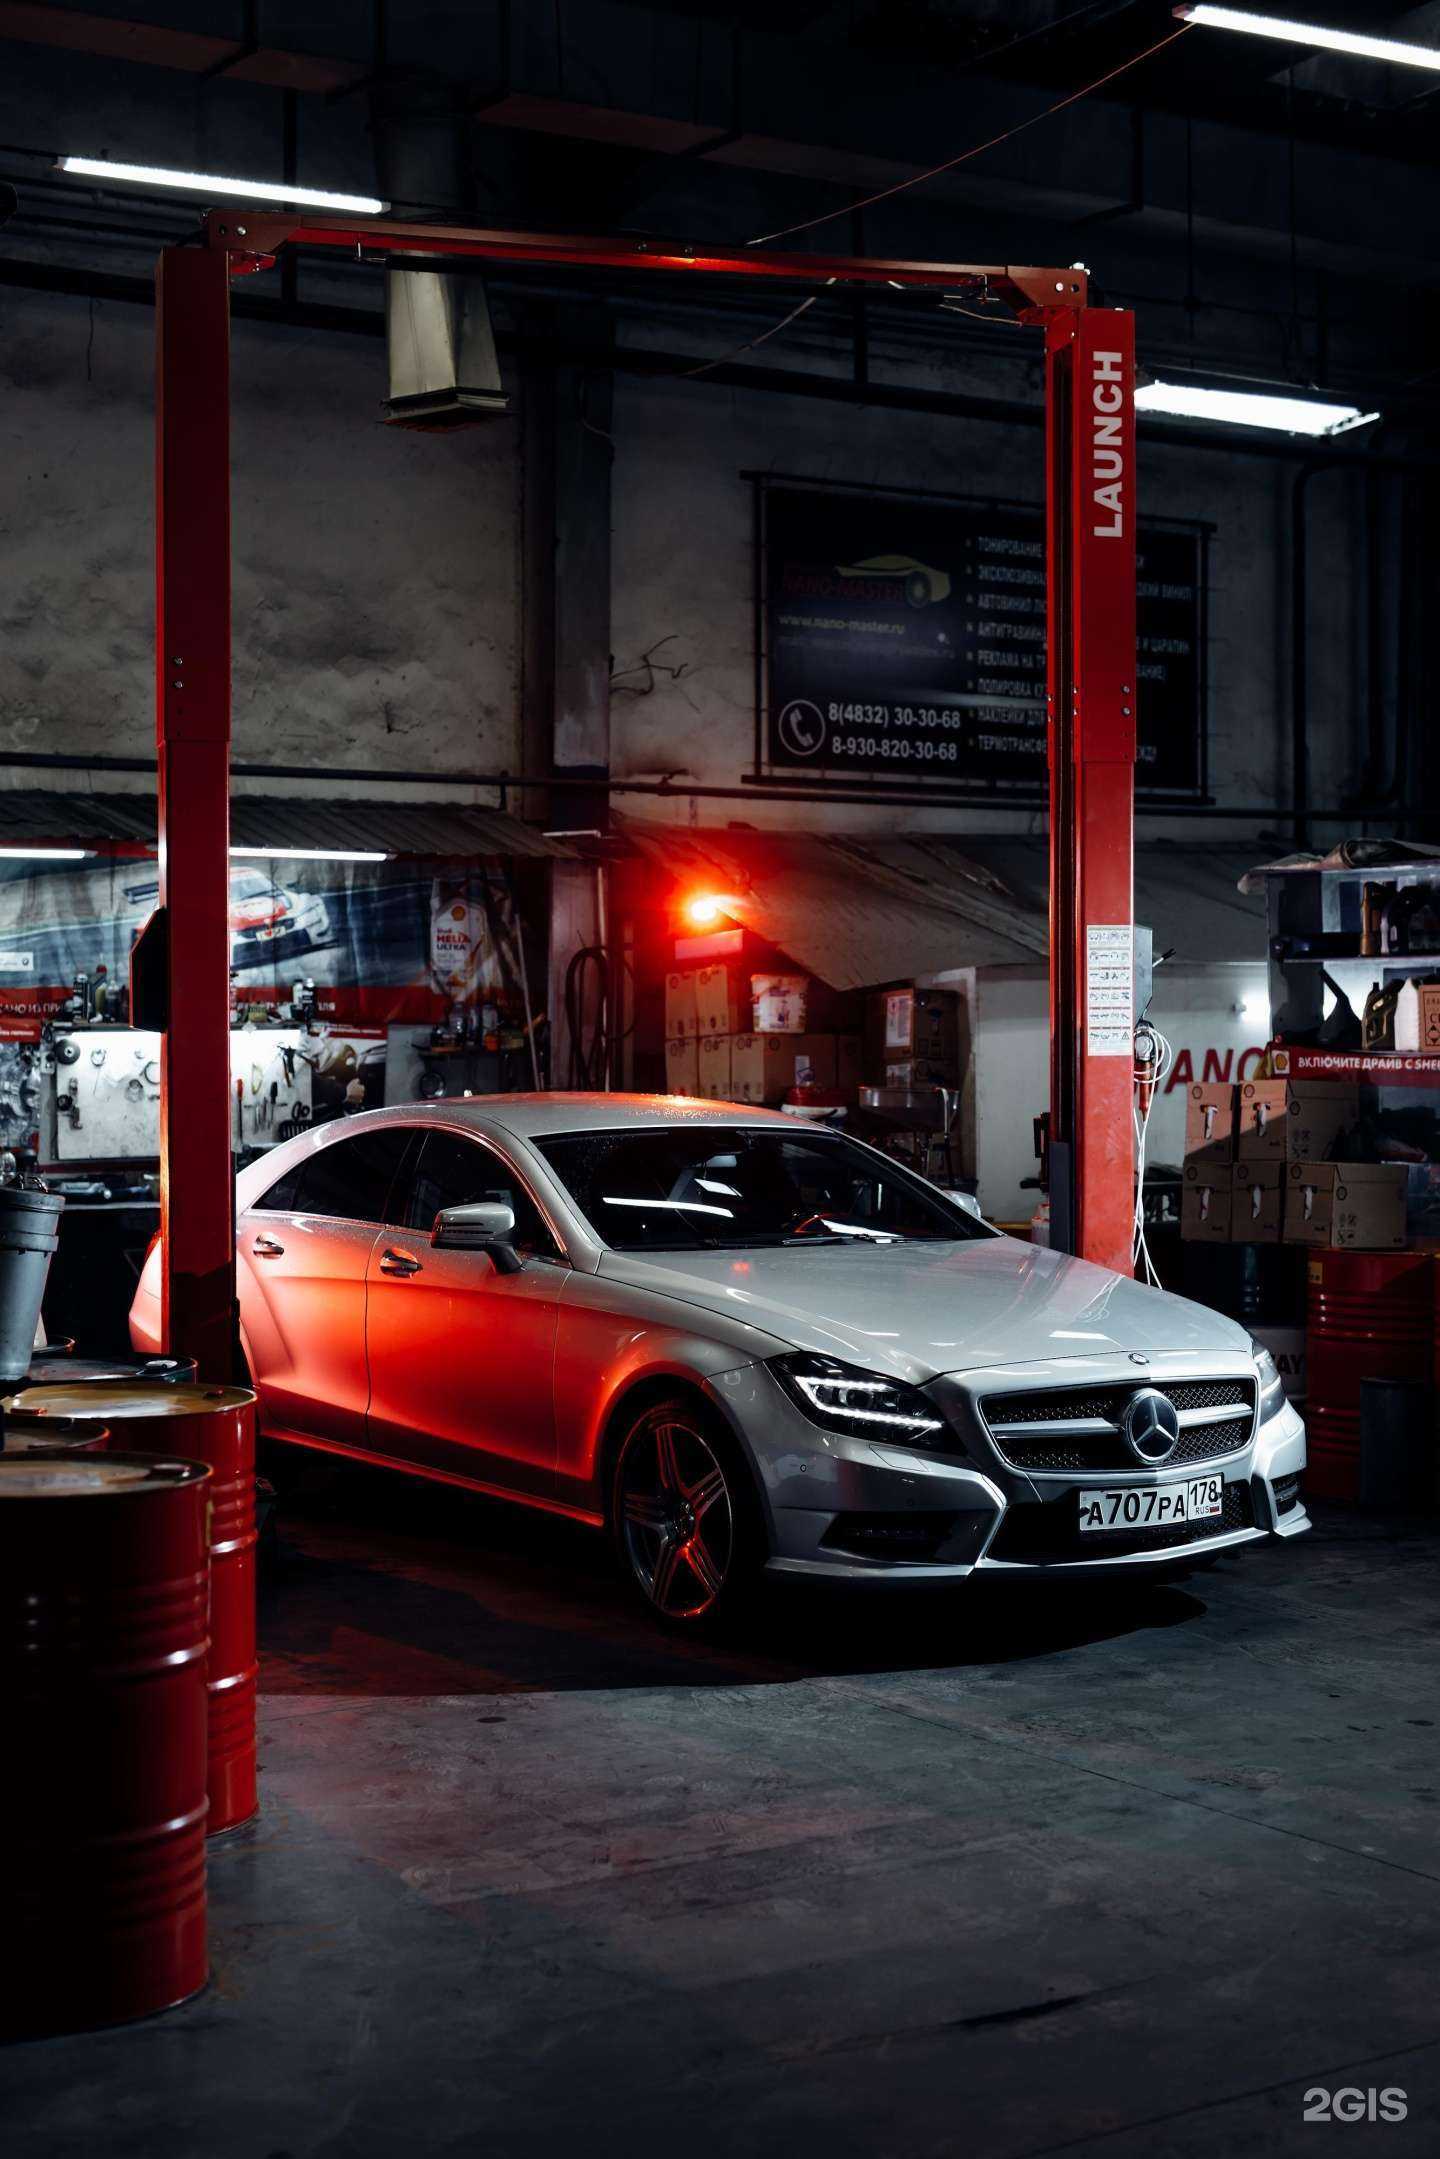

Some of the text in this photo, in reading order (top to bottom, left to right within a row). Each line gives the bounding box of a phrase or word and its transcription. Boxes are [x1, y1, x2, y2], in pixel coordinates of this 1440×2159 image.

[1093, 351, 1123, 537] LAUNCH
[828, 702, 961, 728] 8(4832) 30-30-68
[832, 736, 958, 760] 8-930-820-30-68
[436, 943, 466, 951] ULTRA
[1298, 1056, 1360, 1070] ВКЛЮЧИТЕ
[1190, 1480, 1218, 1506] 178
[1195, 1507, 1210, 1515] RUS
